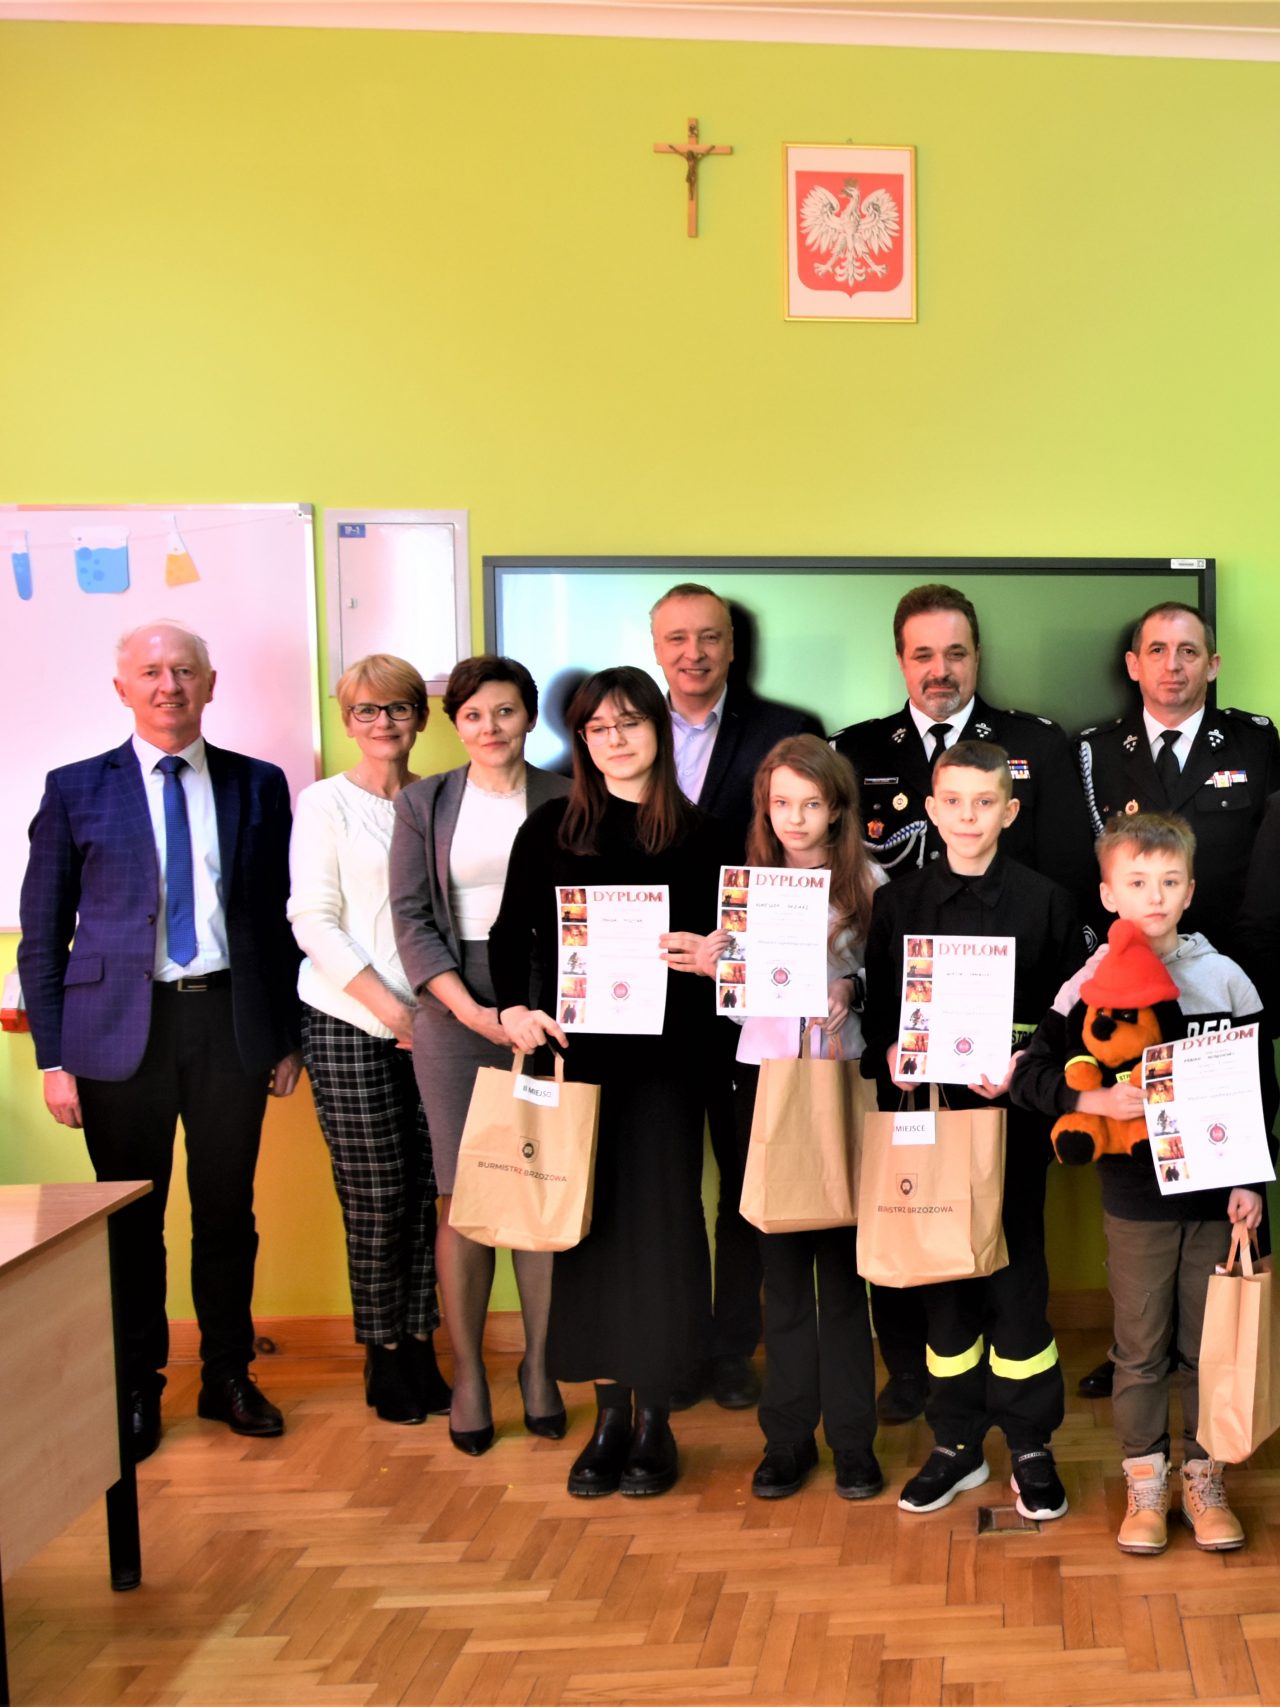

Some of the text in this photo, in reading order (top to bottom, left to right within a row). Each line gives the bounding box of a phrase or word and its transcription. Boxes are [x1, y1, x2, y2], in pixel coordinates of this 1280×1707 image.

[755, 873, 825, 889] DYPLOM
[592, 890, 664, 903] DYPLOM
[938, 943, 1008, 957] DYPLOM
[1181, 1027, 1255, 1051] DYPLOM
[896, 1124, 926, 1133] MIEJSCE
[477, 1160, 567, 1182] BURMISTRZ BRZOZOWA
[907, 1205, 954, 1214] BRZOZOWA
